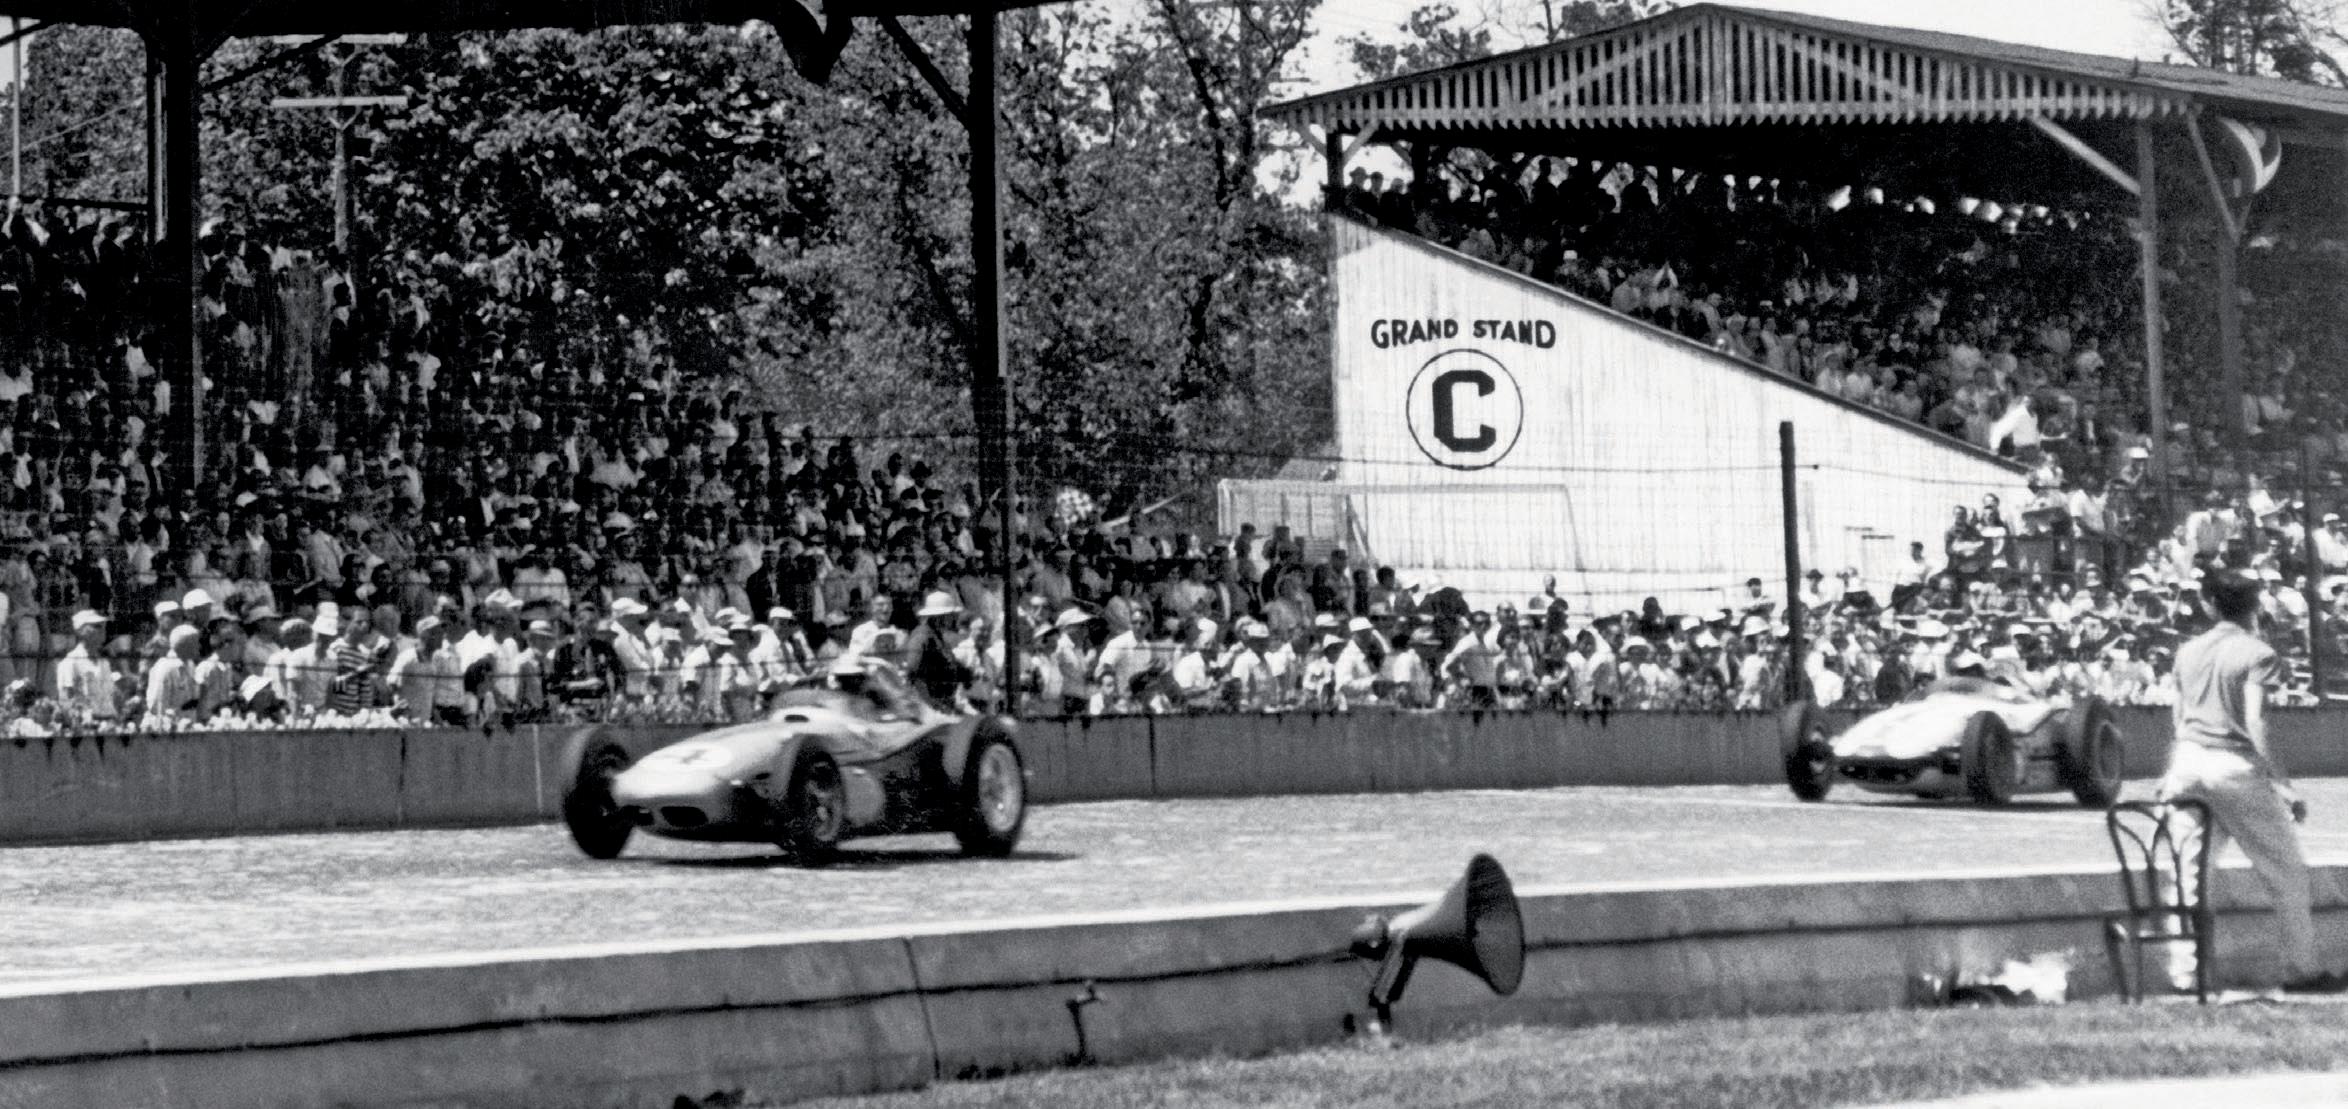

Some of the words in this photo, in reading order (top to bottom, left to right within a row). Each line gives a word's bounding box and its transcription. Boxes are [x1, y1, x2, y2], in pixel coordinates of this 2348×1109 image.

[1371, 318, 1459, 349] GRAND
[1472, 319, 1556, 349] STAND
[1432, 369, 1497, 453] C
